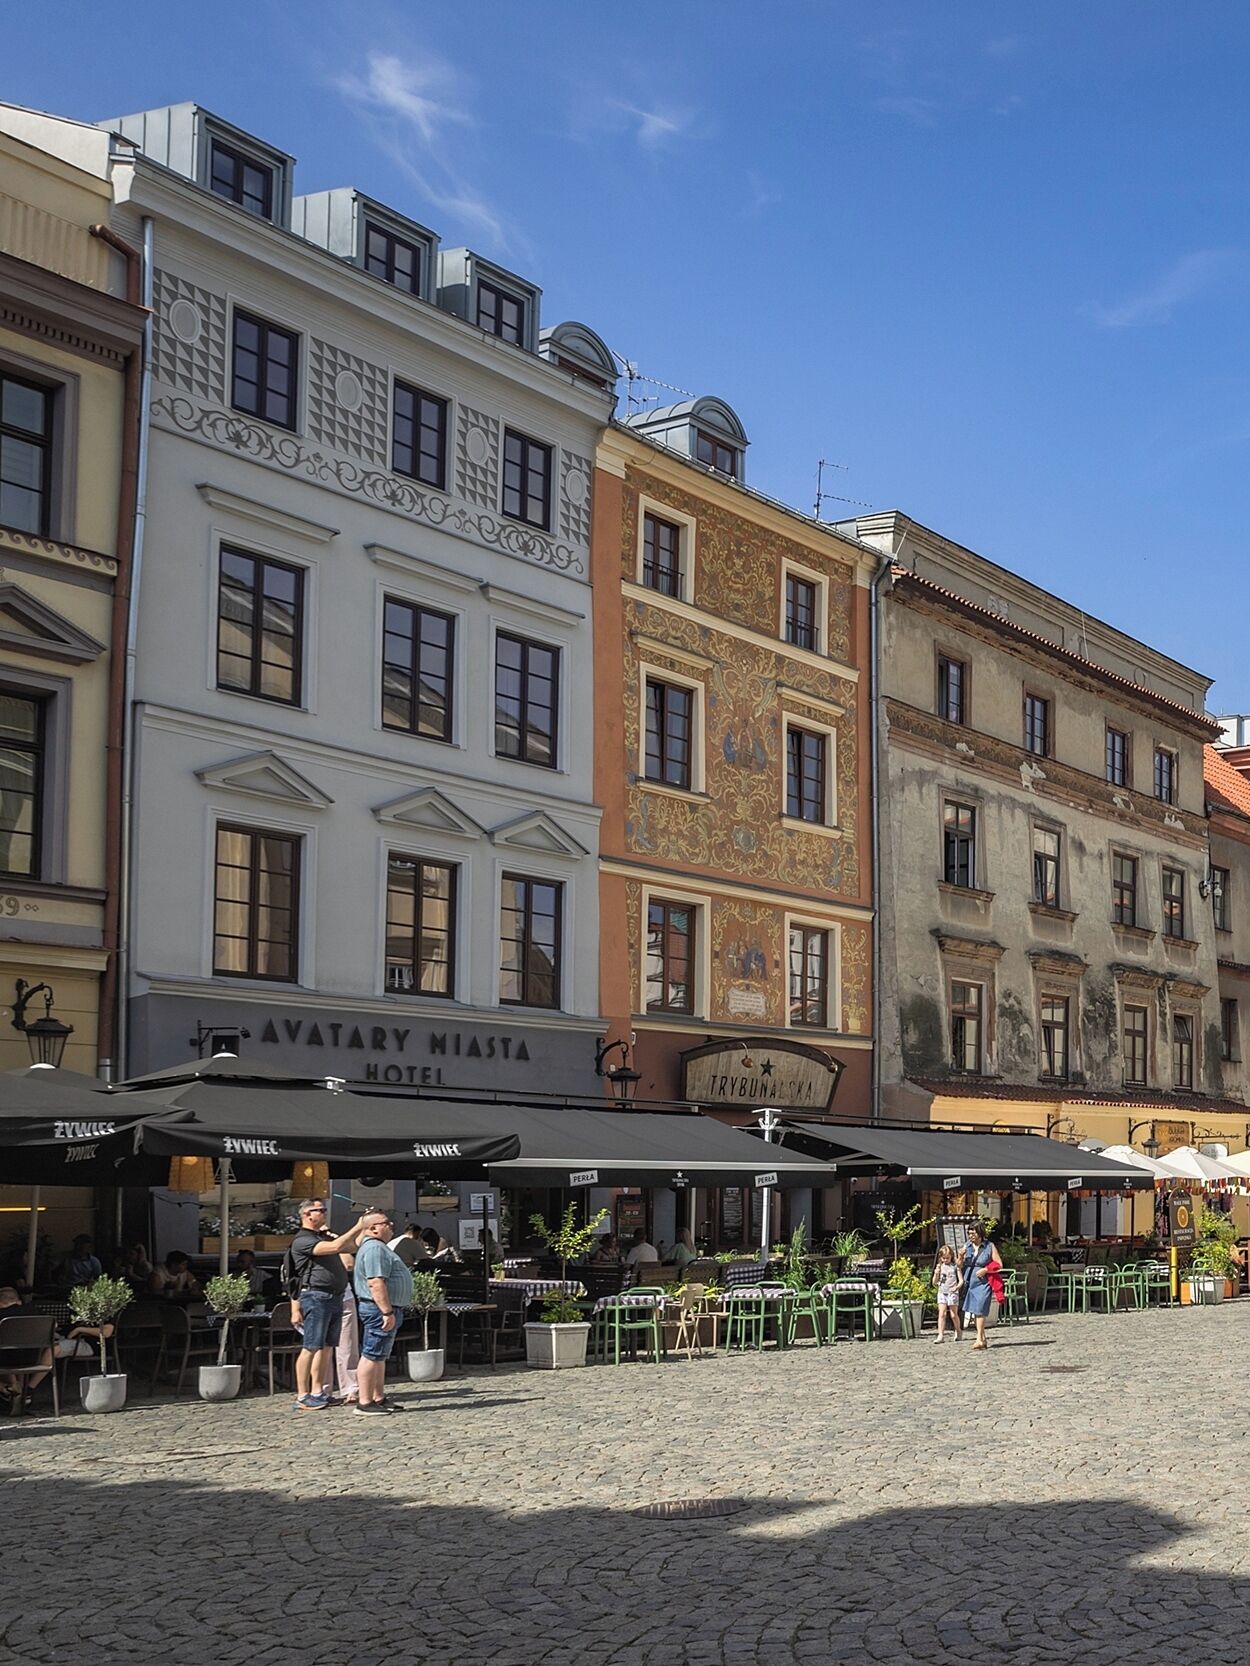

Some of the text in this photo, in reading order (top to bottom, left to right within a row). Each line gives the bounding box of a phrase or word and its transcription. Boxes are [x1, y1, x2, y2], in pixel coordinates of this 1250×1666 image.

[0, 896, 20, 917] 9
[261, 1018, 531, 1061] AVATARY MIASTA
[365, 1063, 446, 1086] HOTEL
[710, 1075, 813, 1101] TRYBUNALSKA
[54, 1120, 116, 1138] ŻYWIEC
[223, 1136, 279, 1155] ŻYWIEC
[413, 1143, 462, 1157] ŻYWIEC
[573, 1173, 595, 1183] PERŁA
[757, 1175, 775, 1185] PERŁA
